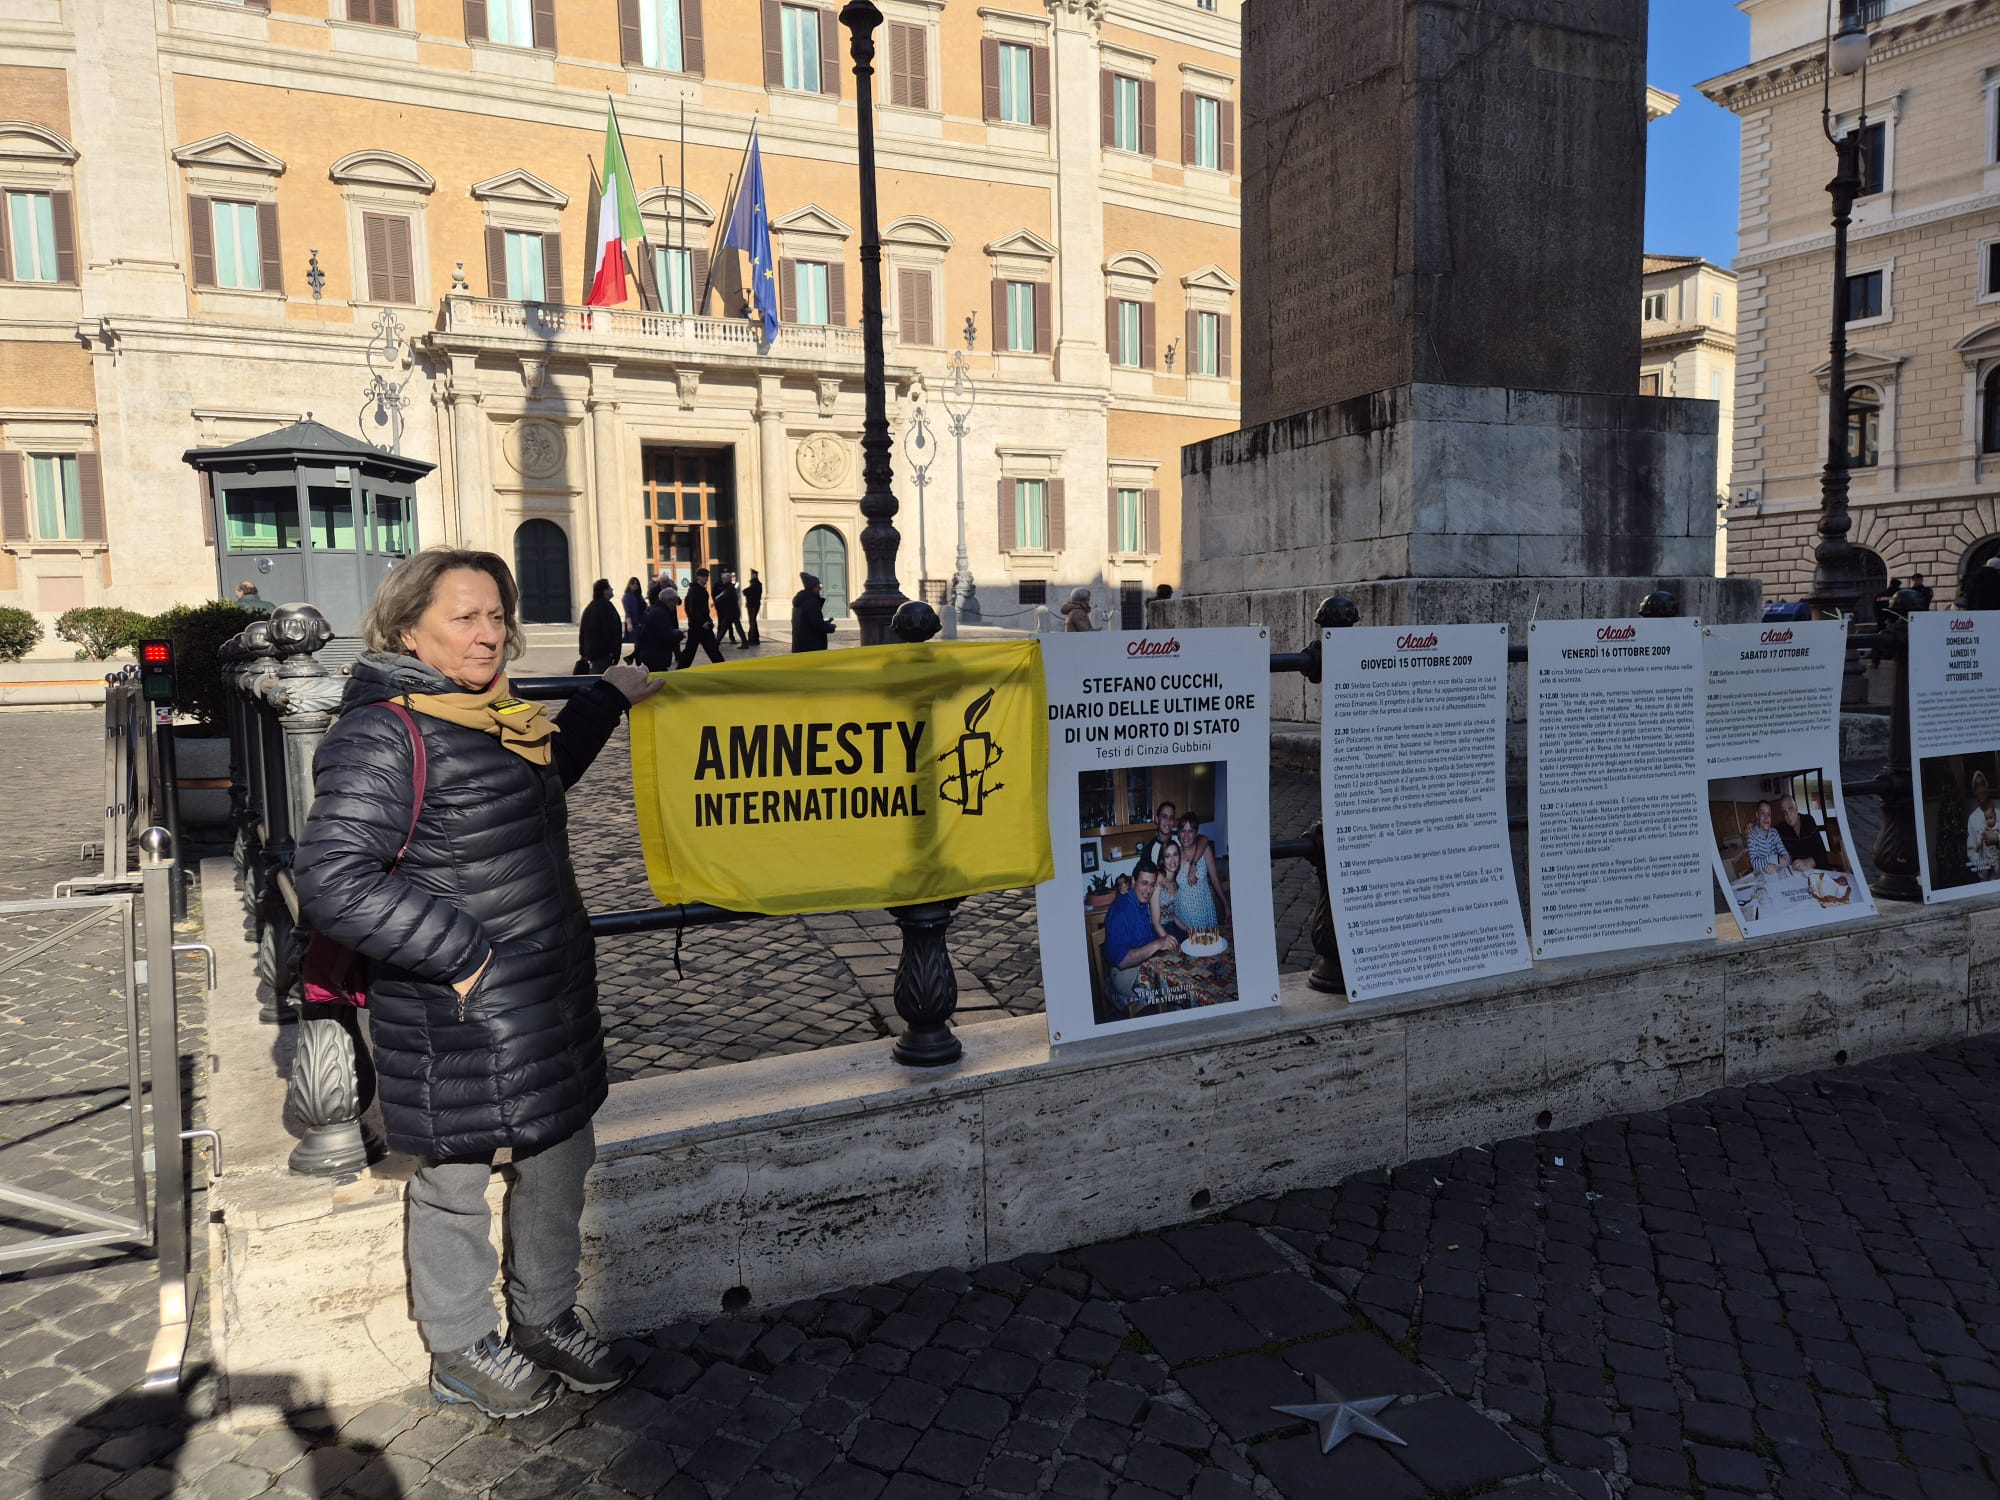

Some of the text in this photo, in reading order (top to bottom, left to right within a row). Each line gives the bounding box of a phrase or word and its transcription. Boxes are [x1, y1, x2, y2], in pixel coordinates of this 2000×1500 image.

[1946, 637, 1972, 646] DOMENICA
[1562, 645, 1671, 659] VENERDÌ 16 OTTOBRE 2009
[1740, 648, 1810, 661] SABATO 17 OTTOBRE
[1950, 647, 1976, 658] LUNEDÌ 19
[1361, 655, 1472, 670] GIOVEDÌ 15 OTTOBRE 2009
[1949, 659, 1979, 669] MARTEDÌ 20
[1082, 673, 1223, 694] STEFANO CUCCHI,
[1946, 672, 1982, 682] OTTOBRE 2009
[1048, 694, 1255, 720] DIARIO DELLE ULTIME ORE
[1065, 718, 1240, 744] DI UN MORTO DI STATO
[694, 720, 926, 781] AMNESTY
[1096, 740, 1211, 759] Testi di Cinzia Gubbini
[695, 785, 927, 827] INTERNATIONAL
